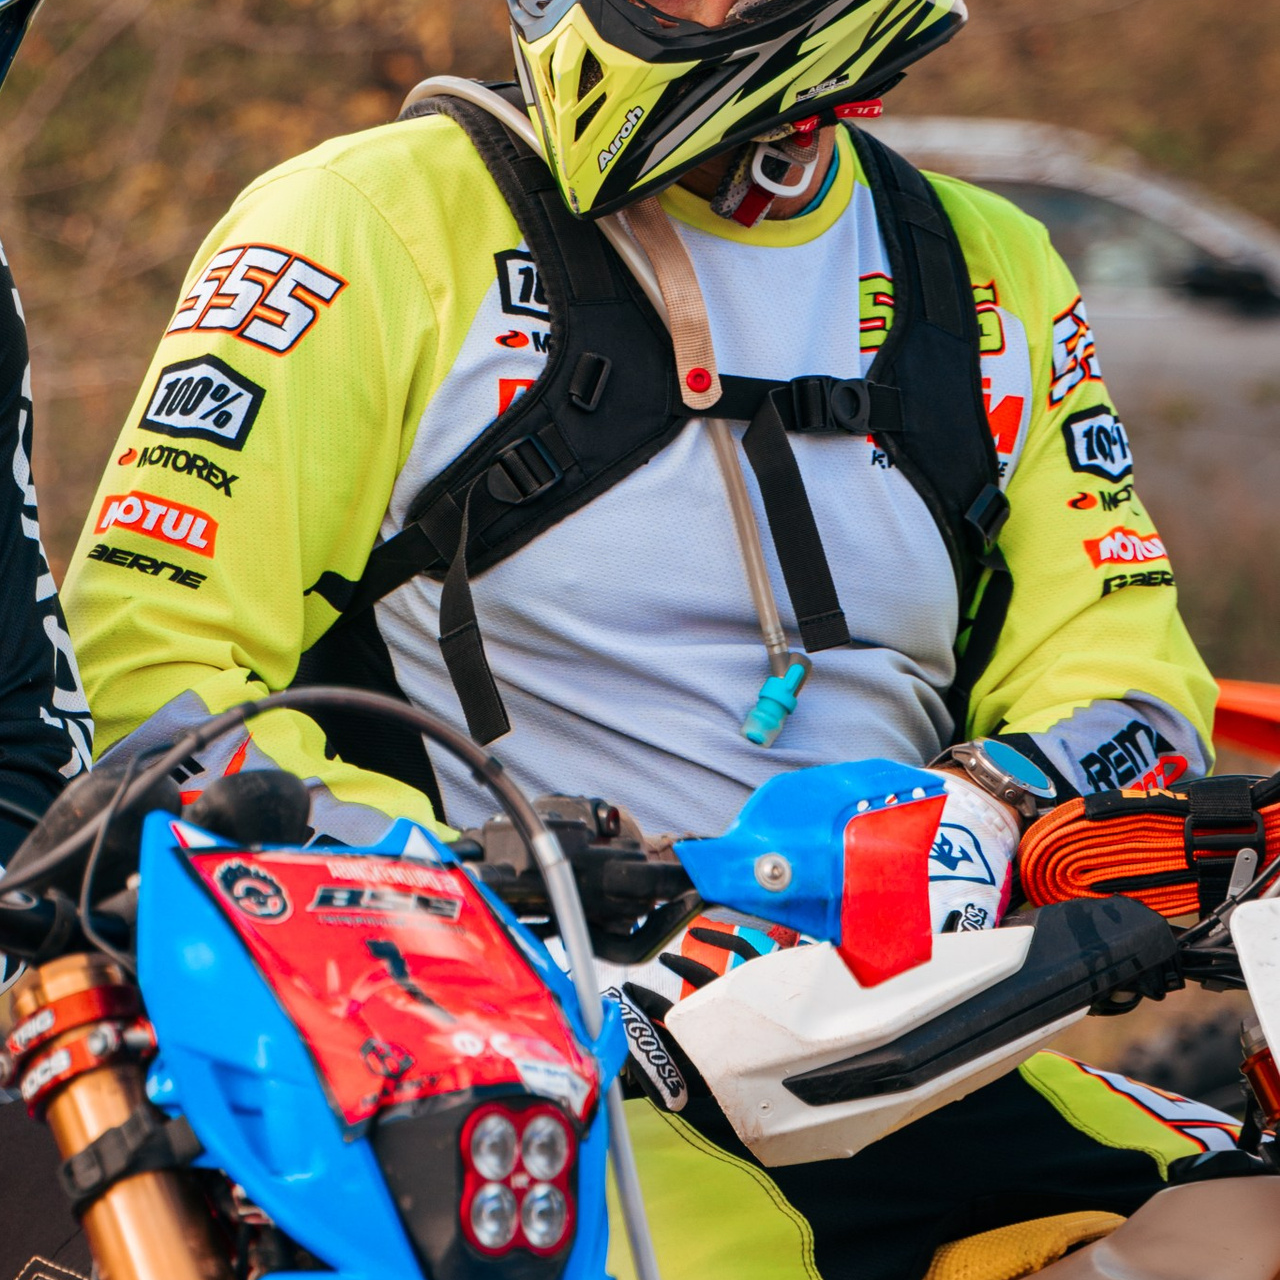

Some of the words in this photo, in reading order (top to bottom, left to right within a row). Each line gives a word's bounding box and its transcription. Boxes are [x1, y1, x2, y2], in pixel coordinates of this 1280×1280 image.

[597, 105, 645, 175] Airoh
[166, 245, 346, 354] 555
[153, 375, 244, 430] 100%
[137, 443, 240, 498] MOTOREX
[100, 495, 210, 550] MOTUL
